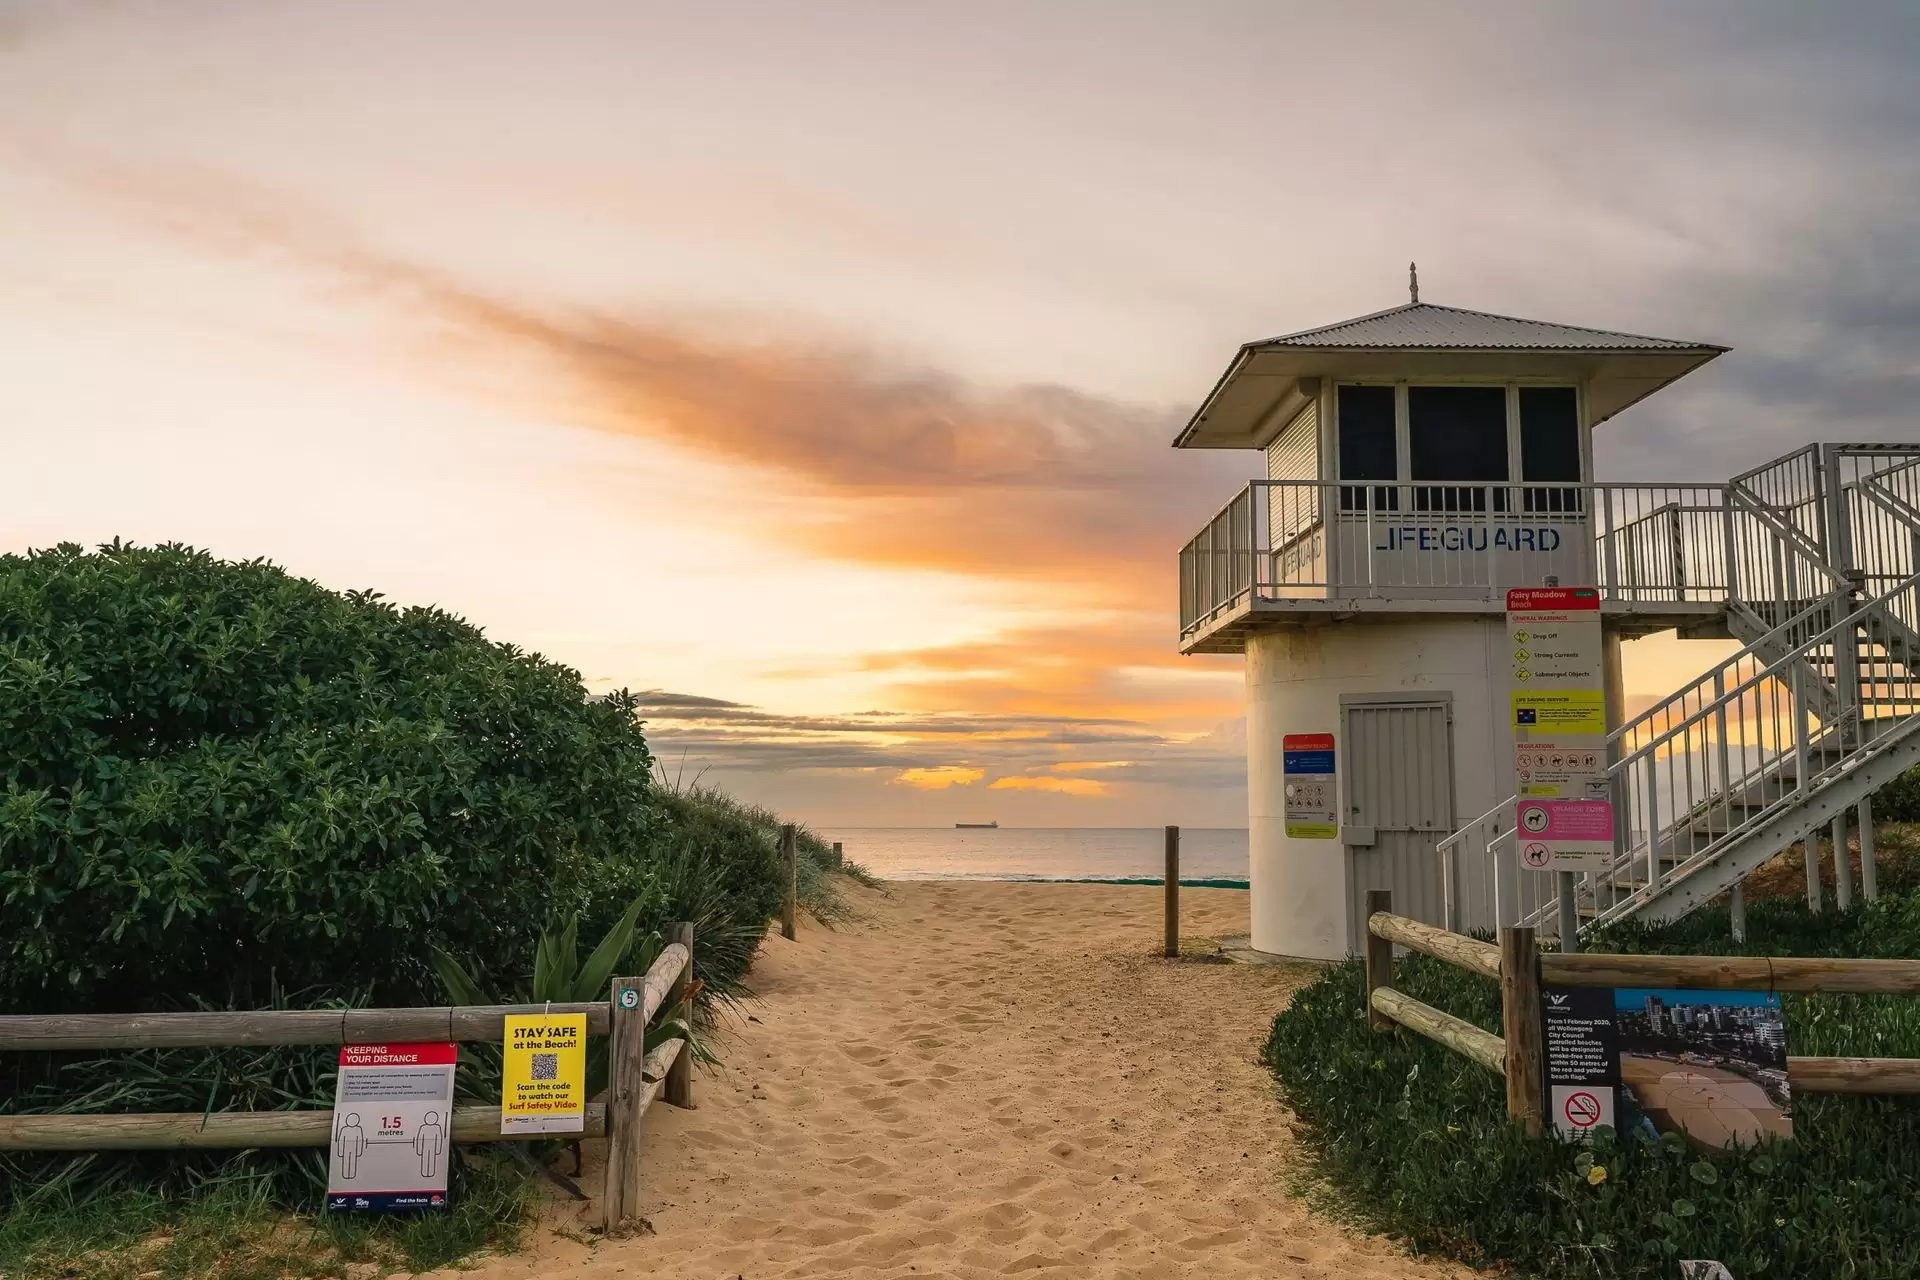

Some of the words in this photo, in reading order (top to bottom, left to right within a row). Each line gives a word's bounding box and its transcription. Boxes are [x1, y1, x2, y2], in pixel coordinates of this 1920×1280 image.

[1510, 592, 1530, 600] Fairy
[627, 992, 634, 1004] 5
[514, 1028, 544, 1038] STAY
[547, 1027, 576, 1037] SAFE
[514, 1041, 524, 1049] at
[545, 1040, 577, 1048] Beach!
[346, 1055, 372, 1063] YOUR
[373, 1054, 418, 1062] DISTANCE
[526, 1102, 552, 1110] Safety
[381, 1117, 402, 1128] 1.5
